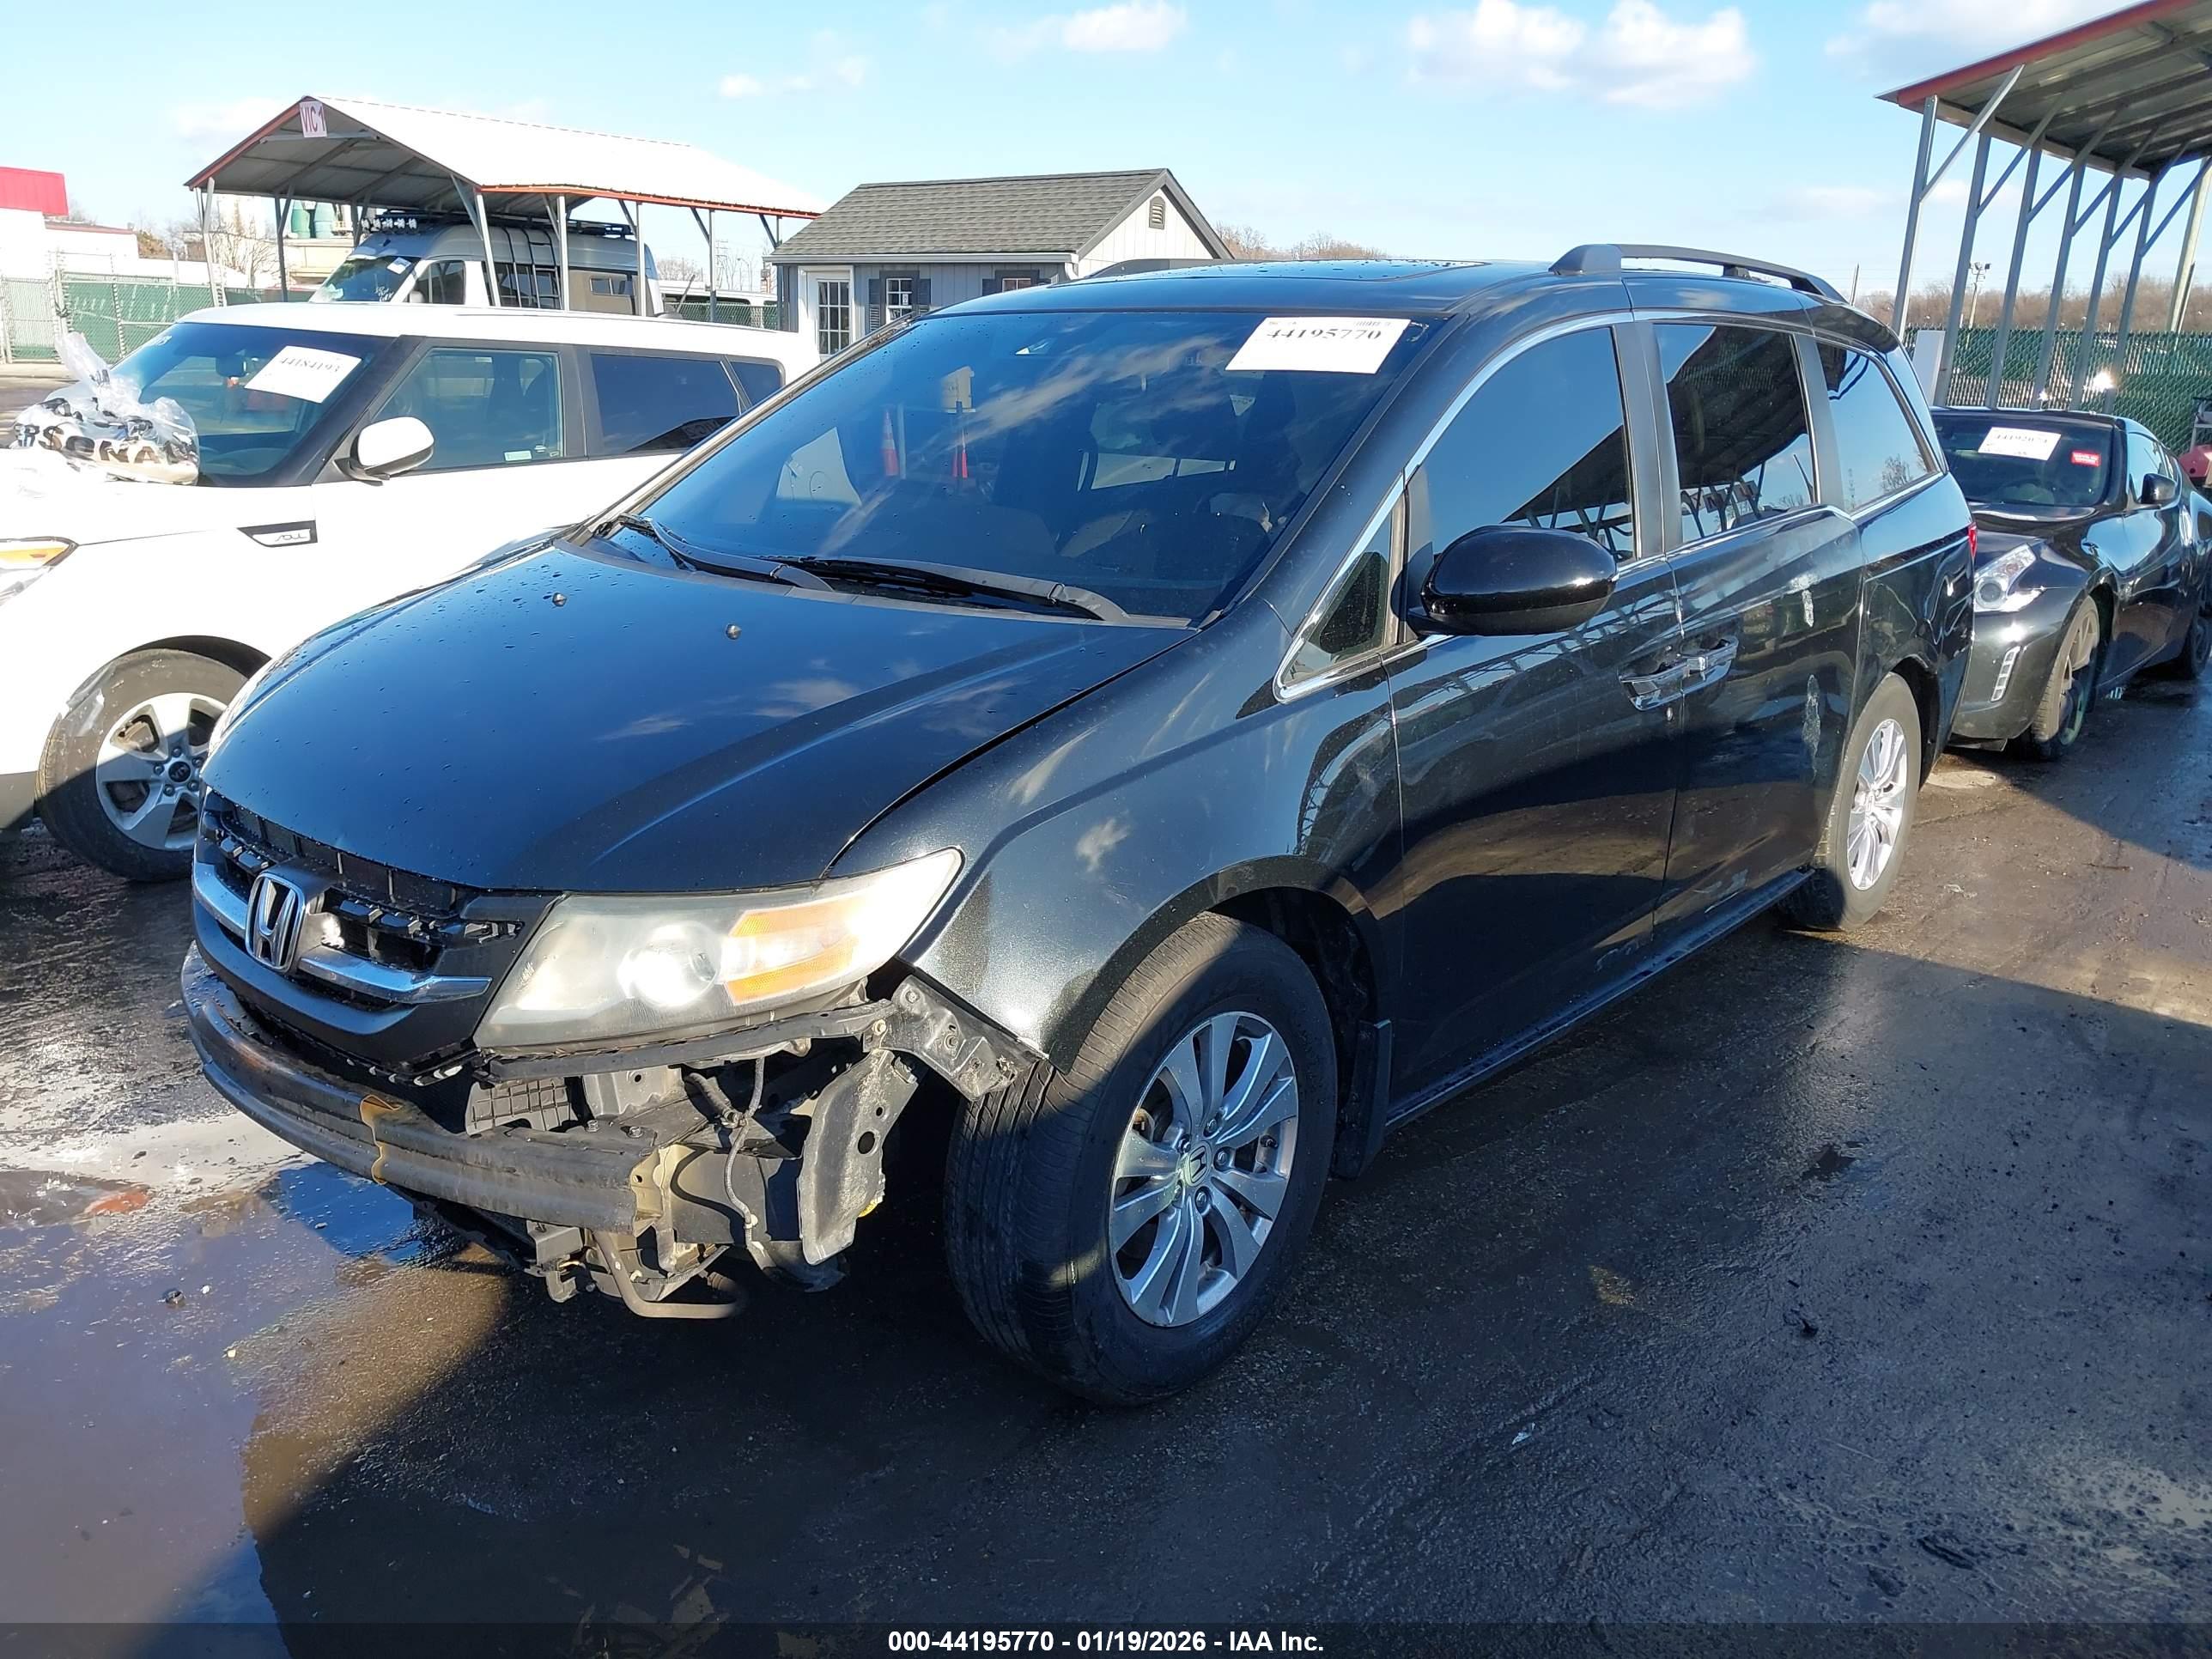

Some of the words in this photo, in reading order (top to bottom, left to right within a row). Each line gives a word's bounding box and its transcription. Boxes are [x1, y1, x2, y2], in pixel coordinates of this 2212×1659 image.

[300, 106, 318, 132] VIC
[319, 106, 325, 131] 1
[1267, 328, 1382, 340] 44195770
